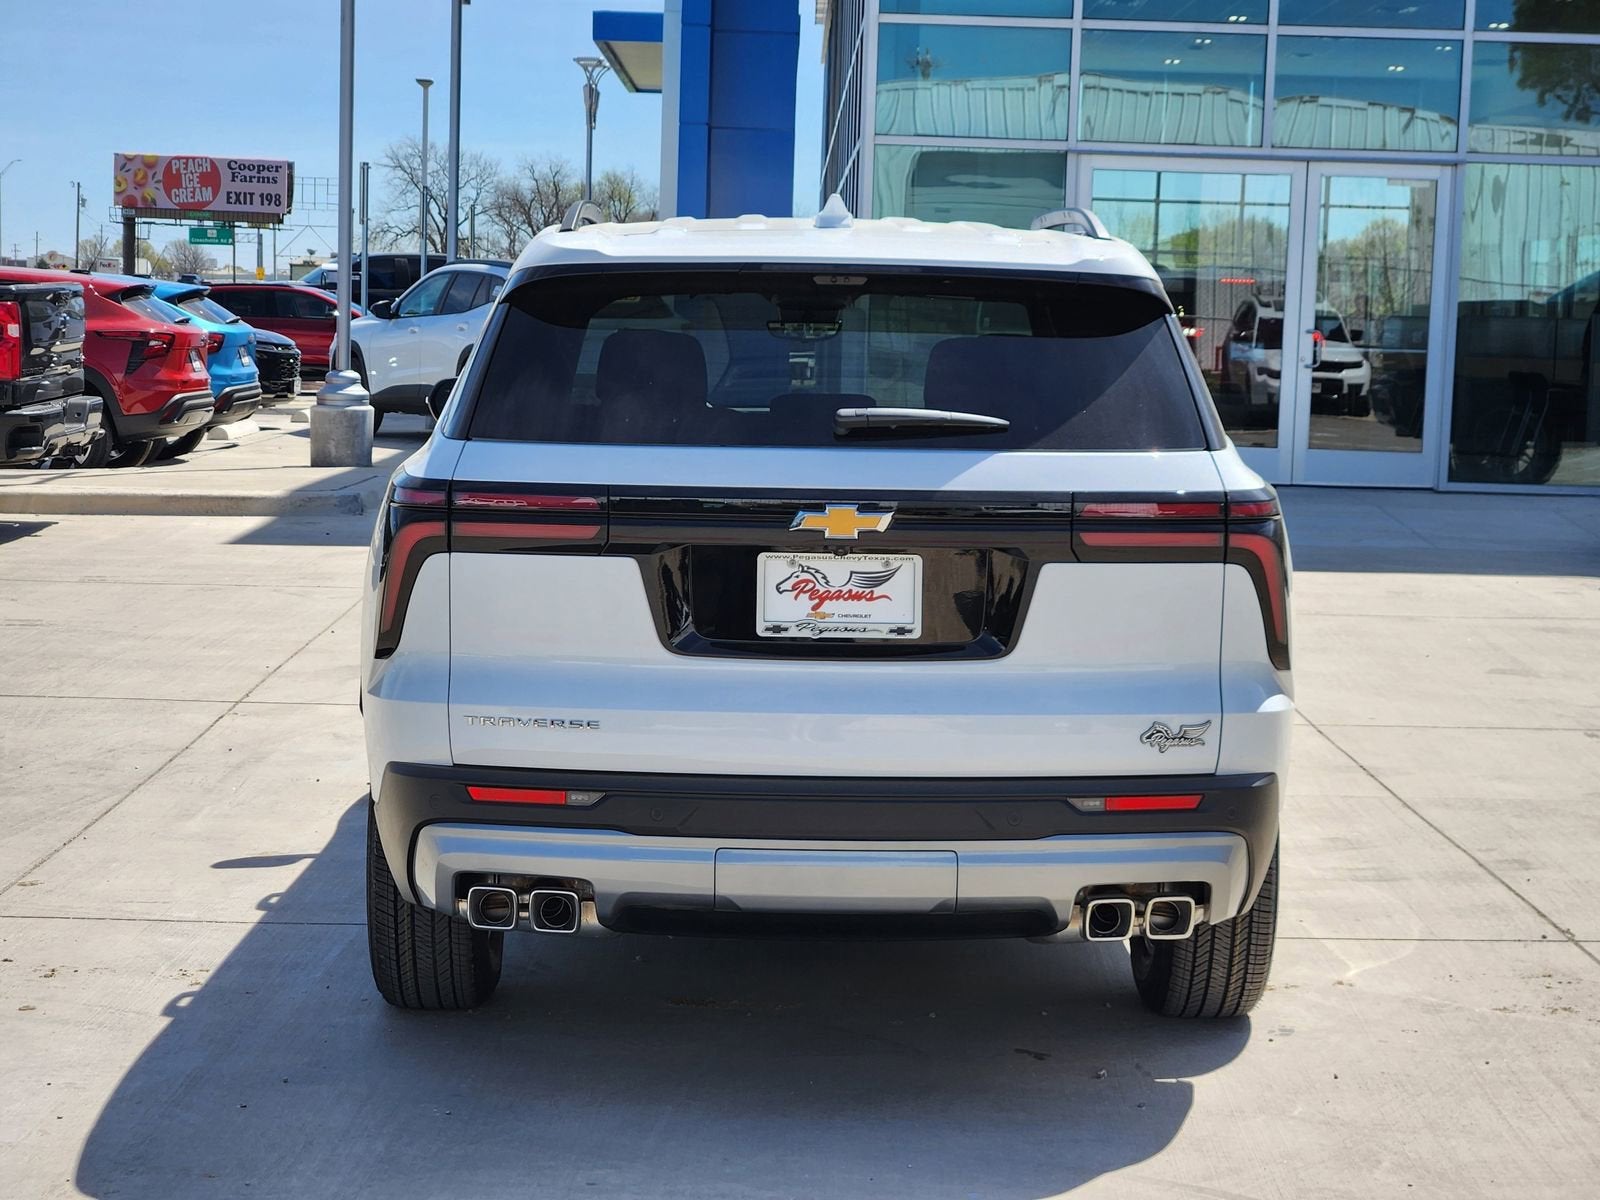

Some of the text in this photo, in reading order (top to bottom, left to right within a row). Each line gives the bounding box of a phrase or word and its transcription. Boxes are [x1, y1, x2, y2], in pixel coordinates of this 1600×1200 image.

[171, 158, 210, 174] PEACH
[227, 160, 282, 174] Cooper
[181, 173, 201, 188] ICE
[230, 172, 279, 185] Farms
[171, 186, 213, 204] CREAM
[226, 191, 282, 207] EXIT 198
[791, 578, 893, 612] Pegasus
[795, 622, 884, 637] Pegasus
[463, 715, 601, 730] TRAVERSE
